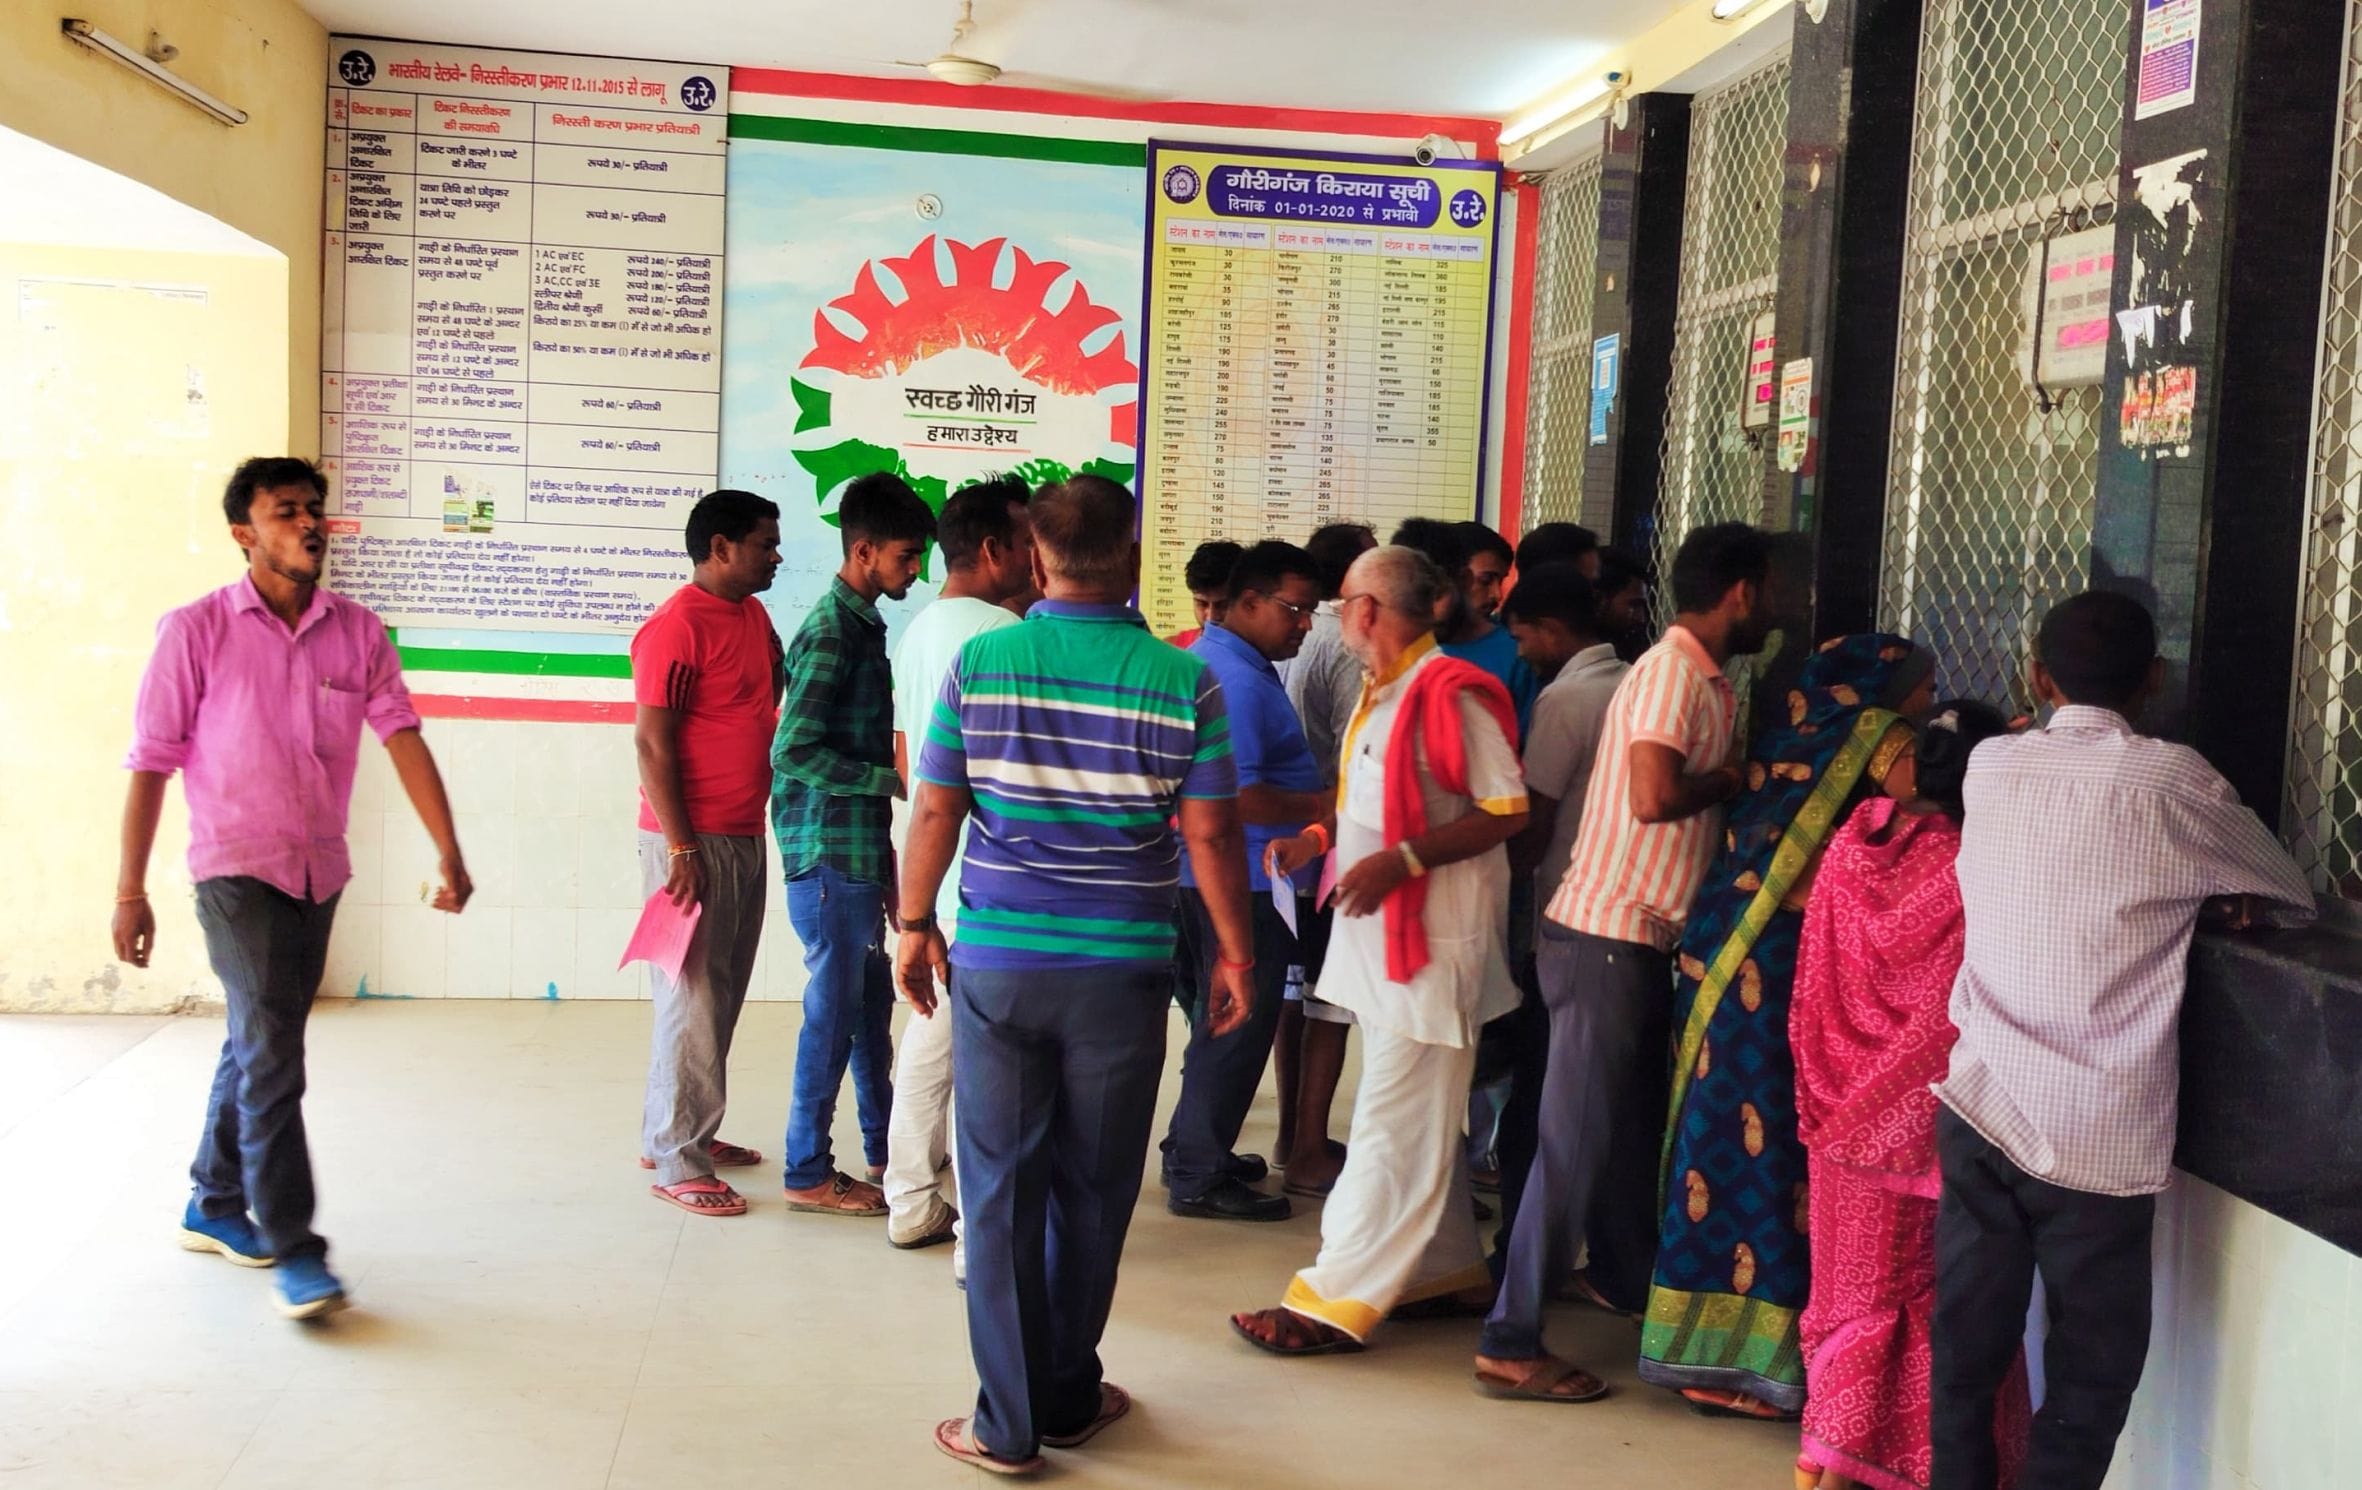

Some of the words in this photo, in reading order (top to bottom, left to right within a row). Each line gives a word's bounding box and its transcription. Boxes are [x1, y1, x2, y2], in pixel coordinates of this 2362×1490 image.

[389, 59, 430, 80] भारतीय
[471, 64, 536, 88] निरस्तीकरण
[540, 74, 568, 91] प्रभार
[572, 78, 623, 94] 12.11.2015
[627, 77, 638, 95] से
[640, 83, 668, 105] लागू
[351, 102, 374, 115] टिकट
[375, 107, 387, 116] का
[389, 108, 412, 118] प्रकार
[434, 101, 458, 112] टिकट
[460, 103, 511, 117] निरस्तीकरण
[444, 121, 457, 131] की
[459, 123, 500, 134] समयावधि
[552, 114, 590, 127] निरस्ती
[594, 120, 622, 130] करण
[625, 121, 653, 132] प्रभार
[656, 123, 700, 135] प्रतियात्री
[421, 143, 445, 154] टिकट
[633, 160, 668, 172] प्रतियात्री
[1226, 170, 1310, 193] गौरीगंज
[1316, 174, 1383, 199] किराया
[1389, 179, 1431, 210] सूची
[1228, 194, 1266, 212] दिनांक
[1275, 204, 1354, 218] 01-01-2020
[1362, 204, 1374, 219] से
[1382, 205, 1418, 222] प्रभावी
[632, 211, 666, 224] प्रतियात्री
[1170, 225, 1187, 238] स्टेशन
[1192, 229, 1200, 237] का
[1204, 230, 1215, 239] नाम
[543, 251, 555, 259] AC
[572, 252, 584, 261] EC
[535, 263, 541, 271] 2
[544, 264, 557, 272] AC
[573, 265, 586, 273] FC
[676, 257, 711, 269] प्रतियात्री
[535, 276, 541, 284] 3
[544, 277, 572, 286] AC,CC
[588, 279, 600, 287] 3E
[676, 270, 710, 281] प्रतियात्री
[676, 283, 710, 294] प्रतियात्री
[675, 295, 710, 307] प्रतियात्री
[673, 309, 707, 319] प्रतियात्री
[905, 388, 962, 411] स्वच्छ
[1004, 388, 1036, 414] गंज
[927, 426, 969, 441] हमारा
